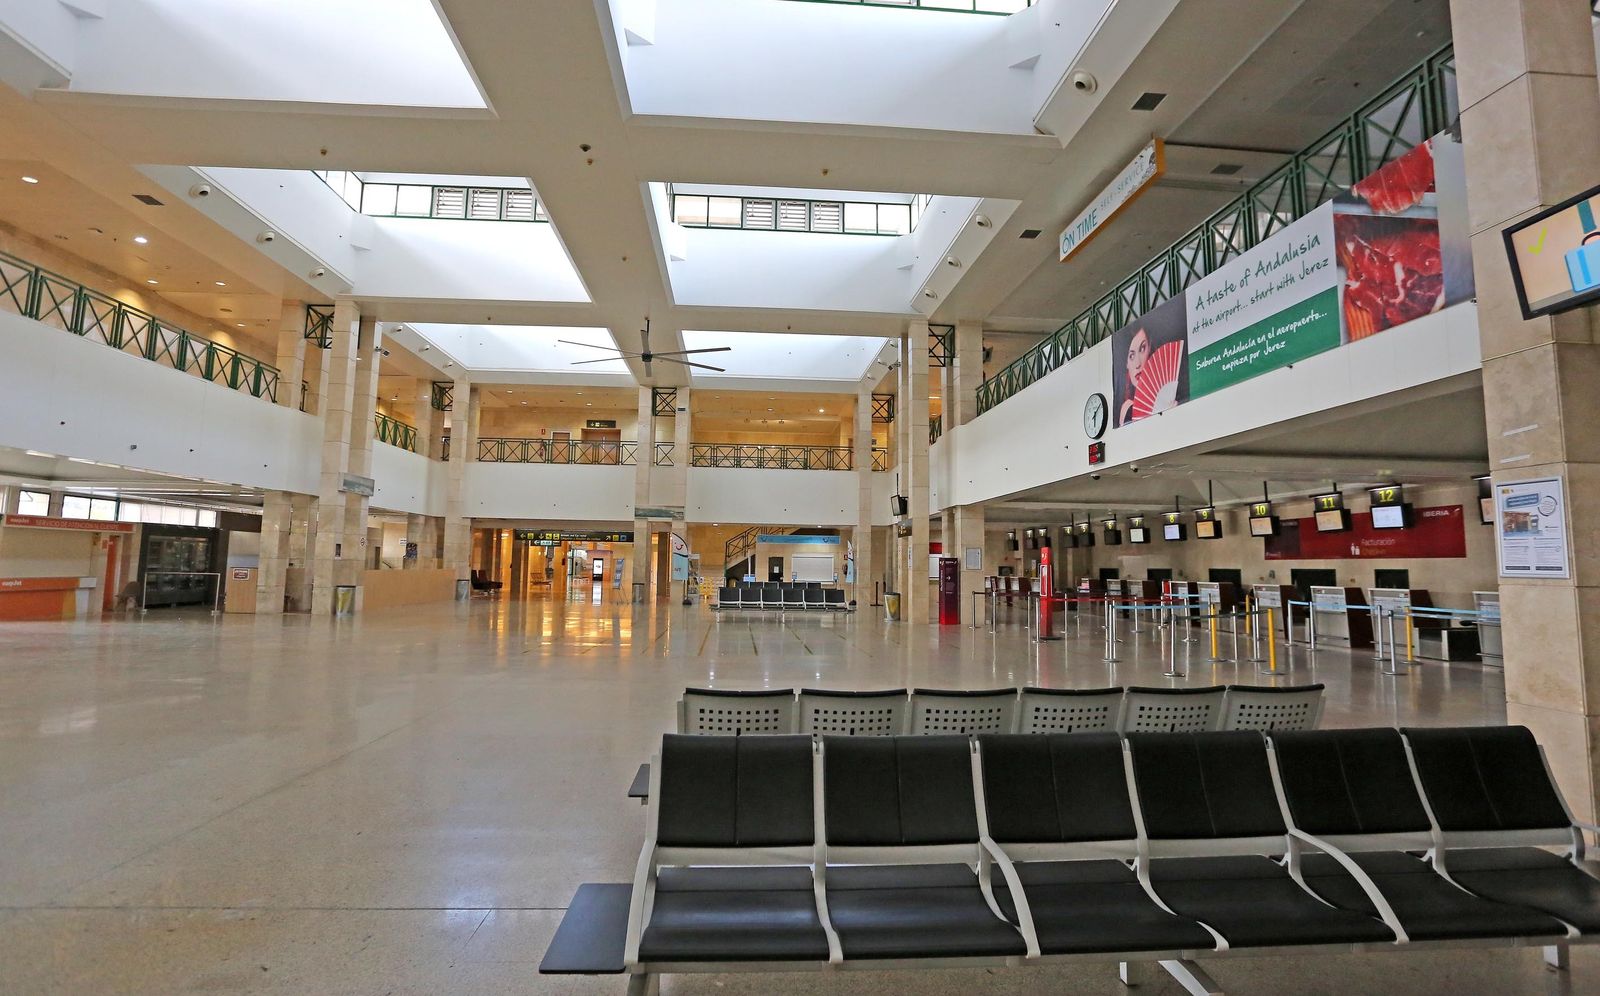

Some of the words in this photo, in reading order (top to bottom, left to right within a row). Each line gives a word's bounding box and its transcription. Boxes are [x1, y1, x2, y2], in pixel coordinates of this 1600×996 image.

[1076, 208, 1098, 241] TIME
[1195, 296, 1205, 311] A
[1206, 280, 1237, 306] taste
[1240, 269, 1251, 288] of
[1255, 234, 1321, 278] Andalusia
[1192, 324, 1201, 334] at
[1201, 317, 1213, 328] the
[1215, 303, 1248, 322] airport...
[1250, 283, 1274, 305] start
[1277, 274, 1295, 291] with
[1299, 258, 1329, 280] Jerez
[1196, 354, 1221, 370] Saborea
[1223, 339, 1256, 358] Andalucía
[1257, 334, 1267, 343] en
[1268, 328, 1275, 339] el
[1222, 355, 1248, 371] empieza
[1249, 351, 1260, 364] por
[1263, 340, 1286, 356] Jerez
[1321, 497, 1335, 509] 11
[1379, 489, 1394, 502] 12
[1169, 514, 1175, 523] 8
[1202, 511, 1208, 519] 9
[1255, 505, 1266, 516] 10
